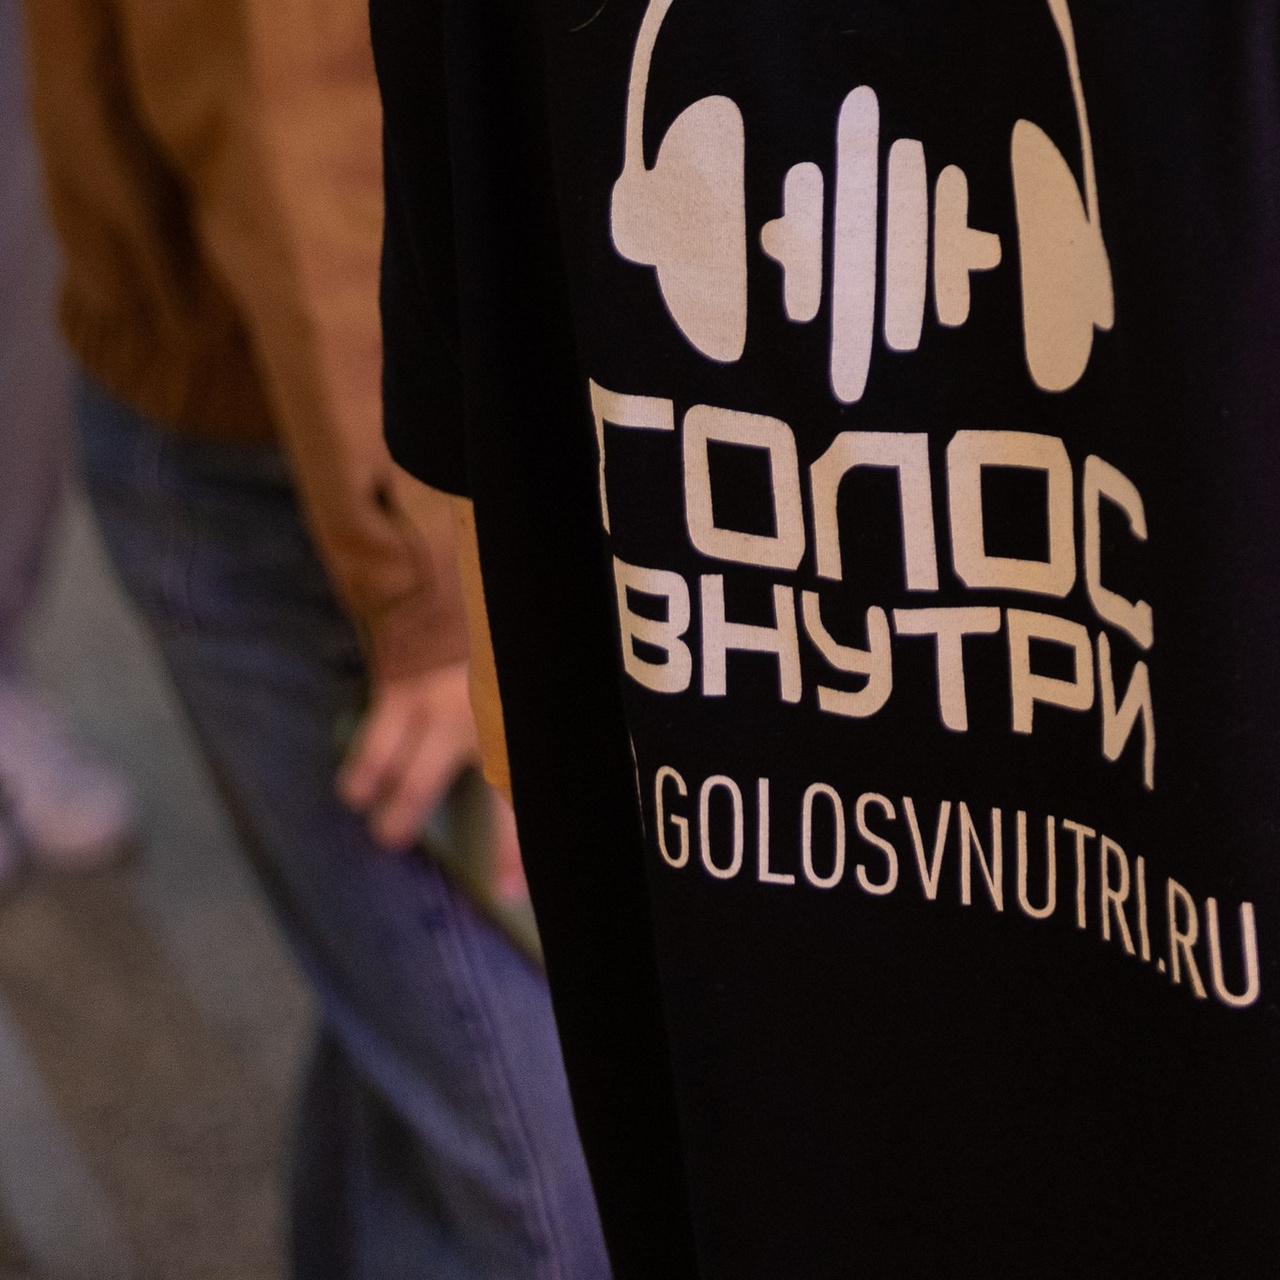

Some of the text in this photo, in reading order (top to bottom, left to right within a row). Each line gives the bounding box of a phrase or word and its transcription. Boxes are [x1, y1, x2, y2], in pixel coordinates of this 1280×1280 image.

[588, 377, 1155, 651] ГОЛОС
[612, 555, 1156, 791] ВНУТРИ
[655, 765, 1261, 1008] GOLOSVNUTRI.RU
